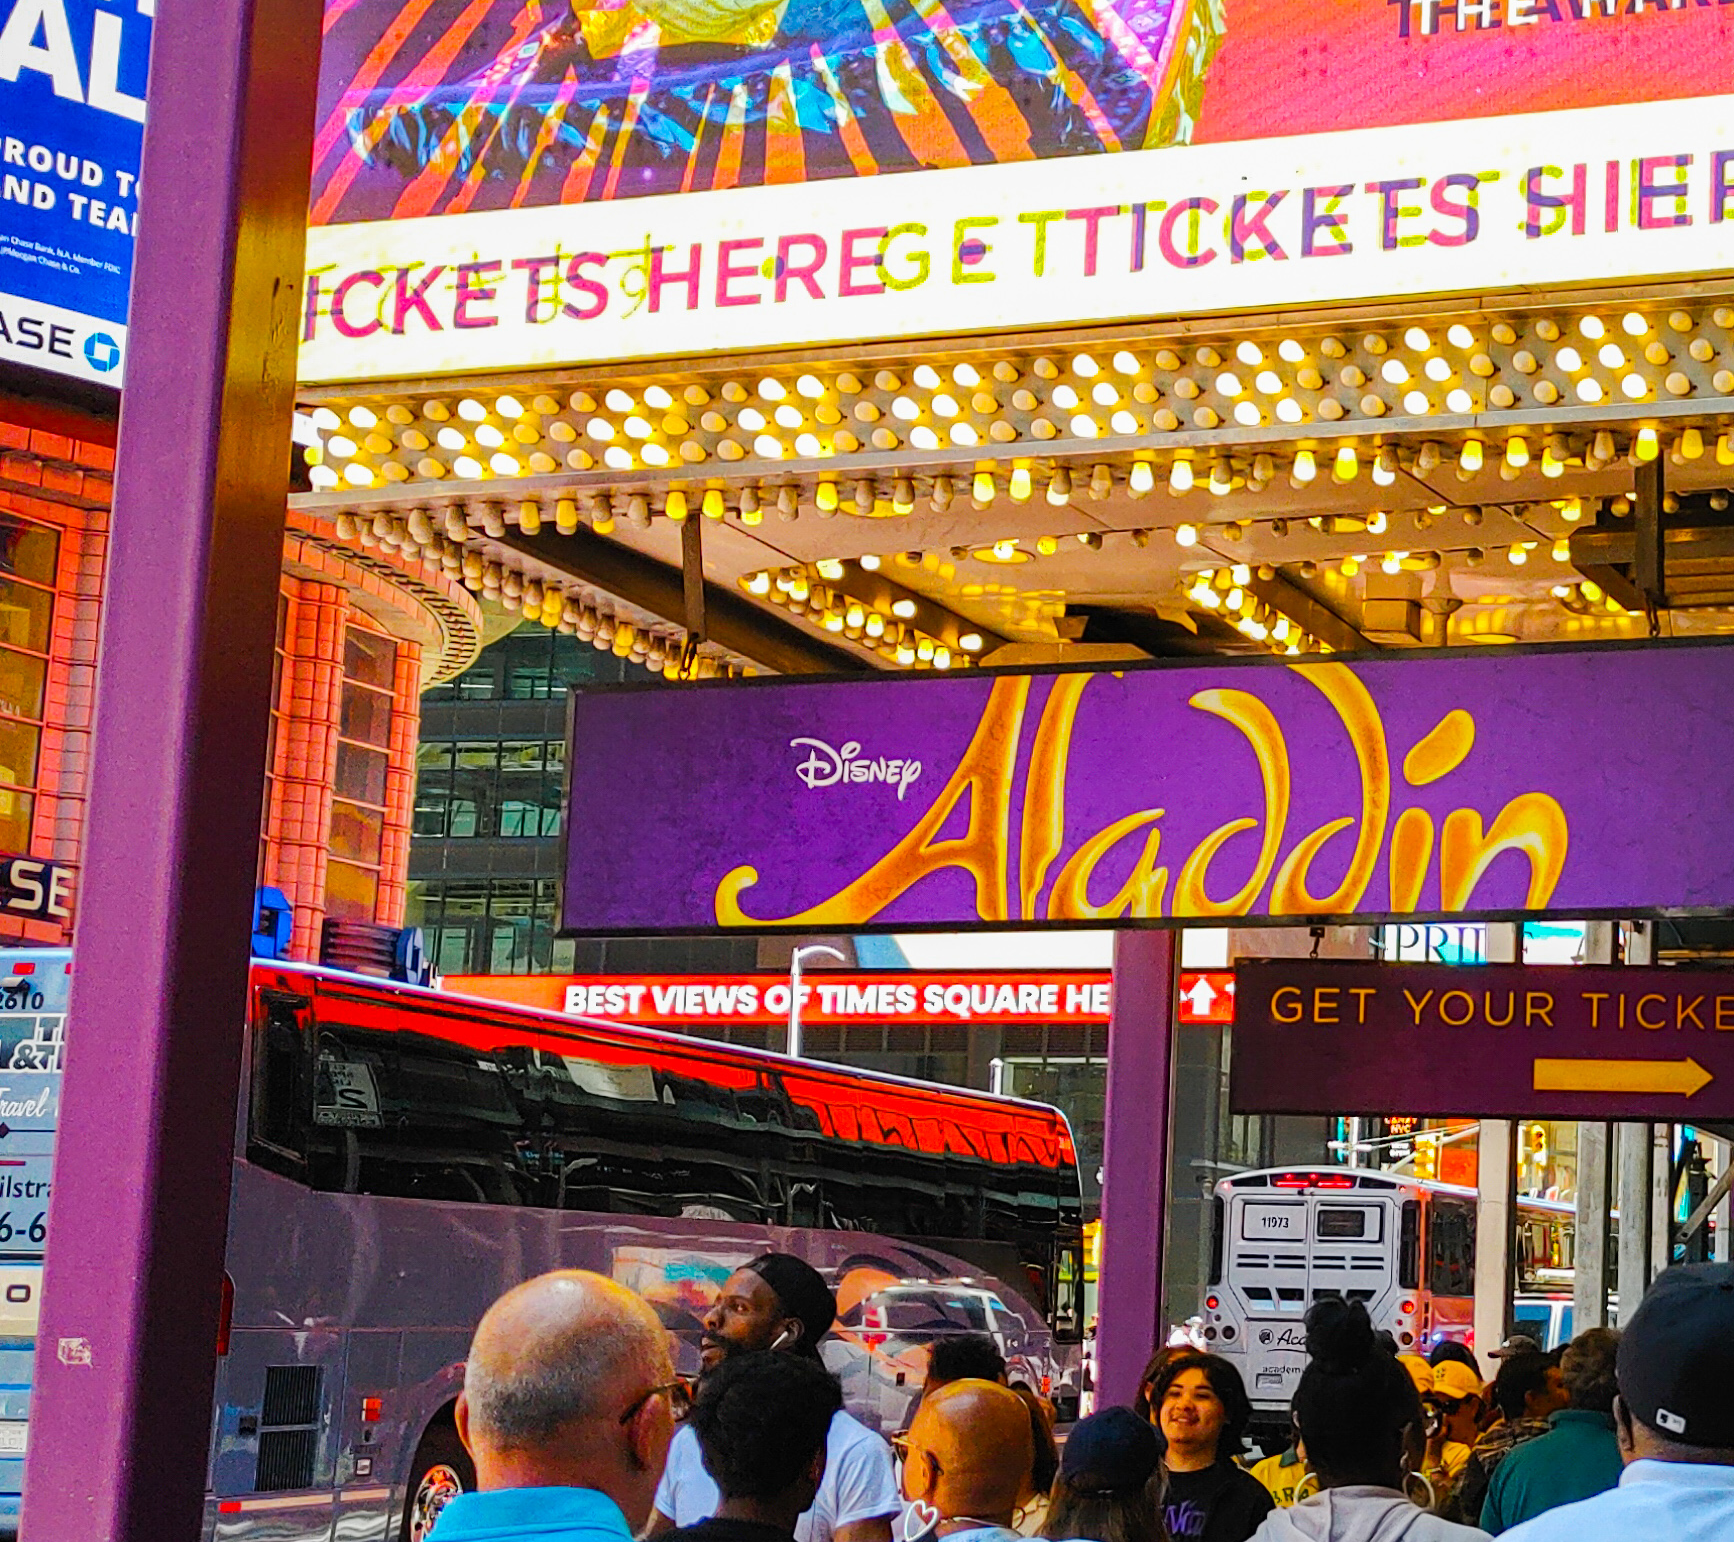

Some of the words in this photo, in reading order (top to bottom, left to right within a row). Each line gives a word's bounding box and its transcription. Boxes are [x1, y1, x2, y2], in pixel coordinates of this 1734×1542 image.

[0, 135, 103, 187] ROUD
[68, 192, 138, 238] TEA
[646, 226, 888, 314] HERE
[789, 737, 923, 801] Disney
[715, 661, 1569, 928] Aladdin
[563, 985, 647, 1015] BEST
[651, 985, 759, 1015] VIEWS
[763, 985, 812, 1015] OF
[816, 984, 917, 1015] TIMES
[923, 984, 1061, 1020] SQUARE
[1270, 985, 1376, 1026] GET
[1401, 988, 1555, 1028] YOUR
[1261, 1216, 1290, 1229] 11973
